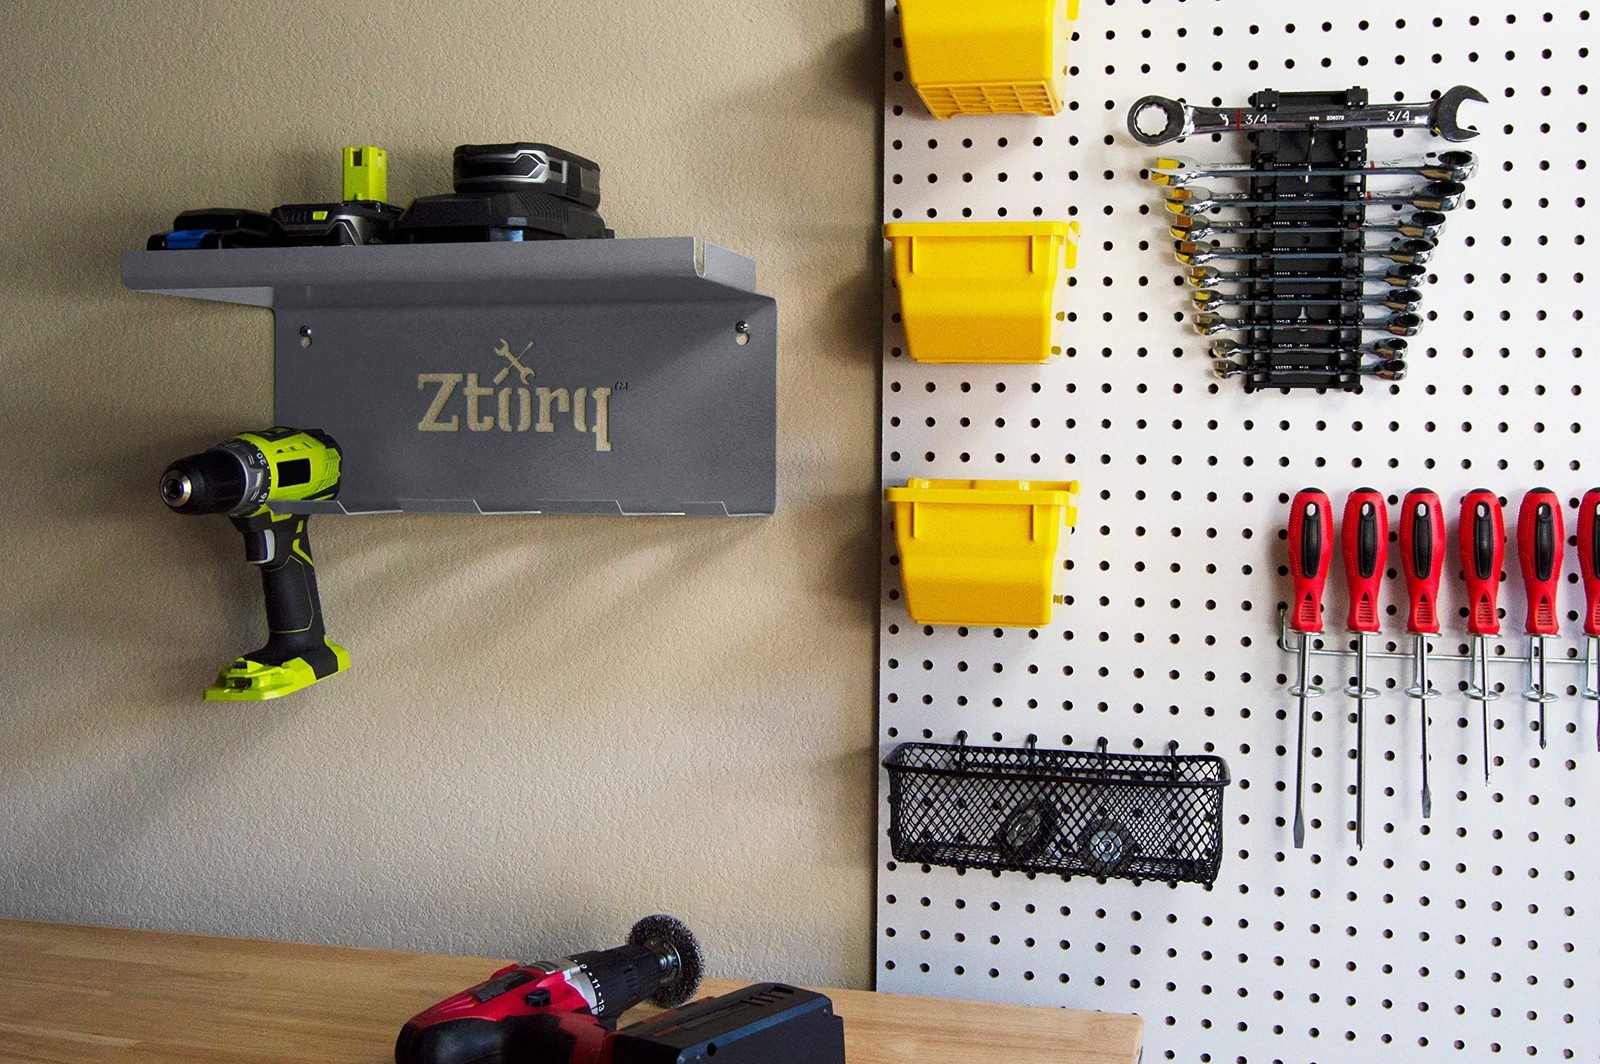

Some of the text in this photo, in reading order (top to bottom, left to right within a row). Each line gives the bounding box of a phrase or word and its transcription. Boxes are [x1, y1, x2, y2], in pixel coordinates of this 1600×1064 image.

[1245, 110, 1410, 125] 3/4 3/4
[417, 373, 613, 452] Ztorq
[591, 978, 601, 989] 11
[598, 999, 605, 1012] 13
